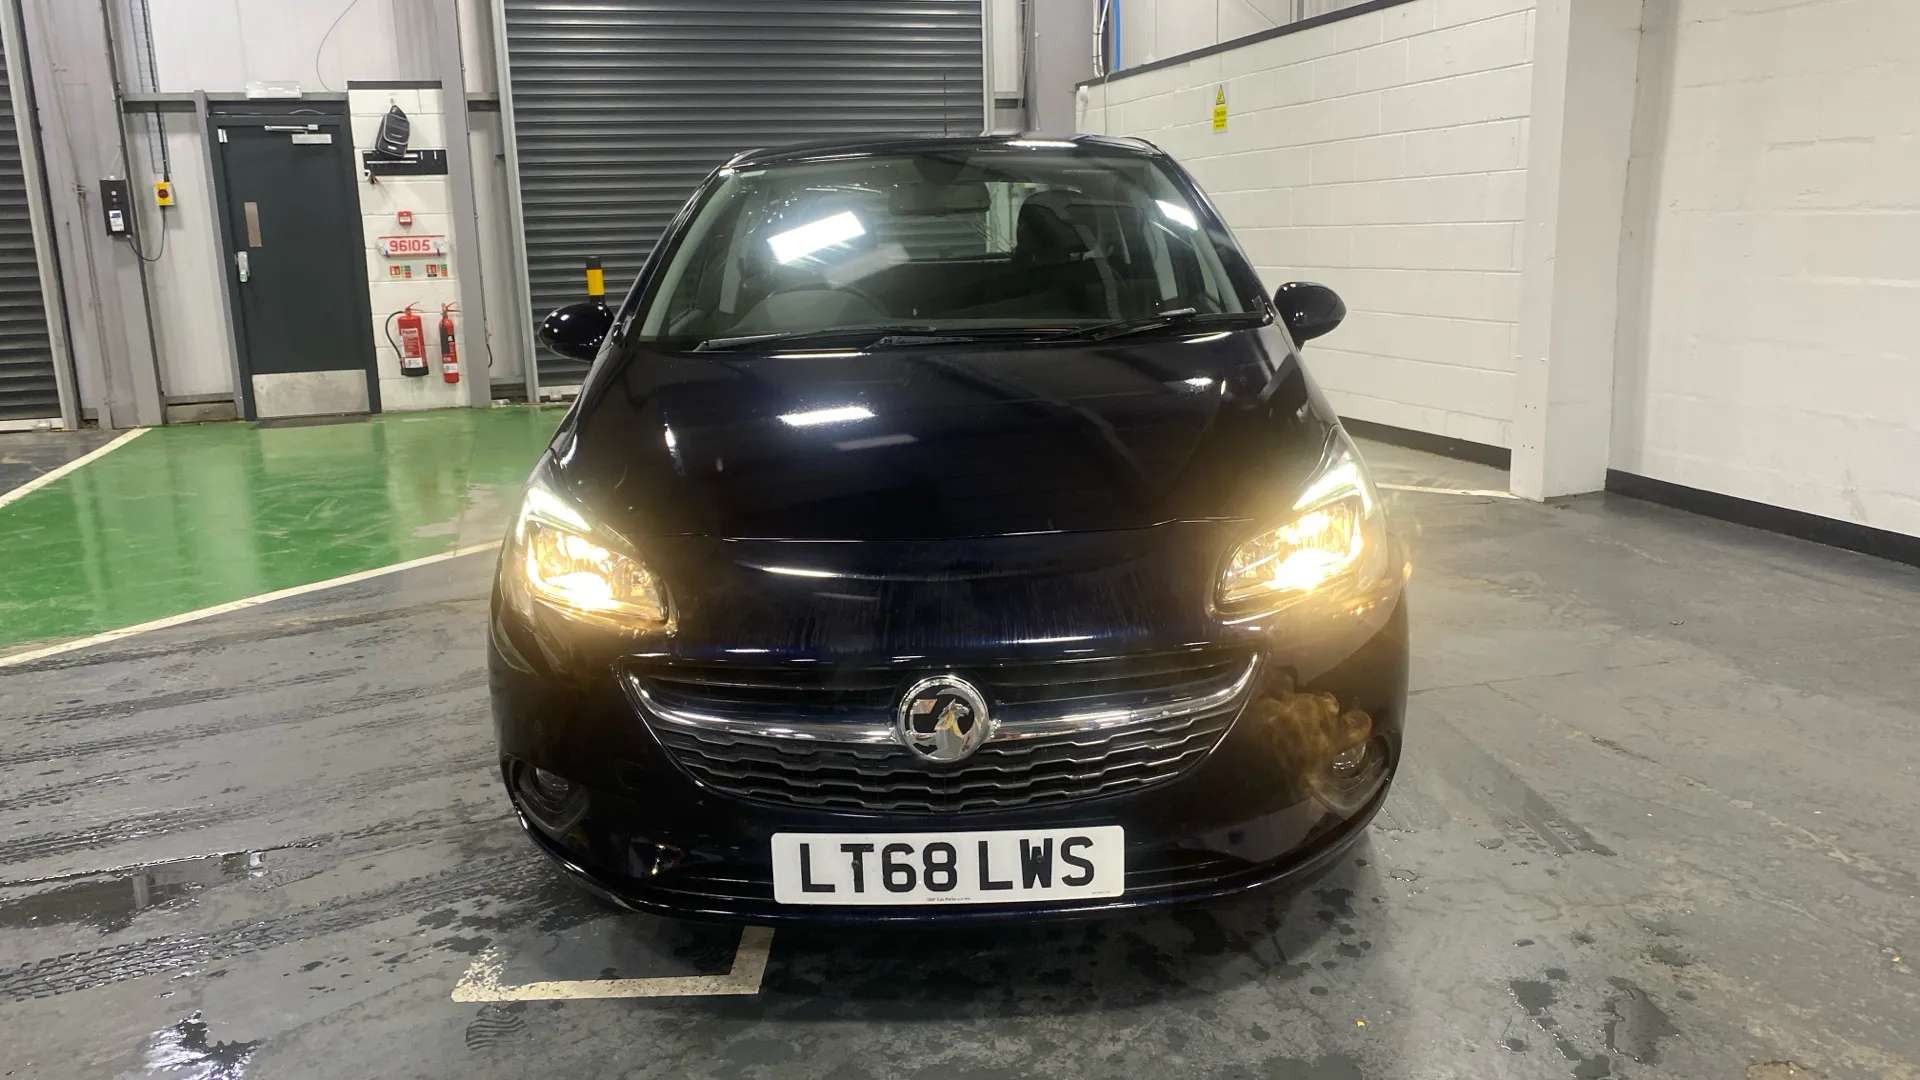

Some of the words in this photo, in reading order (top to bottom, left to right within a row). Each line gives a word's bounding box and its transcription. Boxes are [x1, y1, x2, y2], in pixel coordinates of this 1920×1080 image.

[389, 239, 431, 252] 96105
[799, 842, 958, 893] LT68
[978, 836, 1095, 891] LWS
